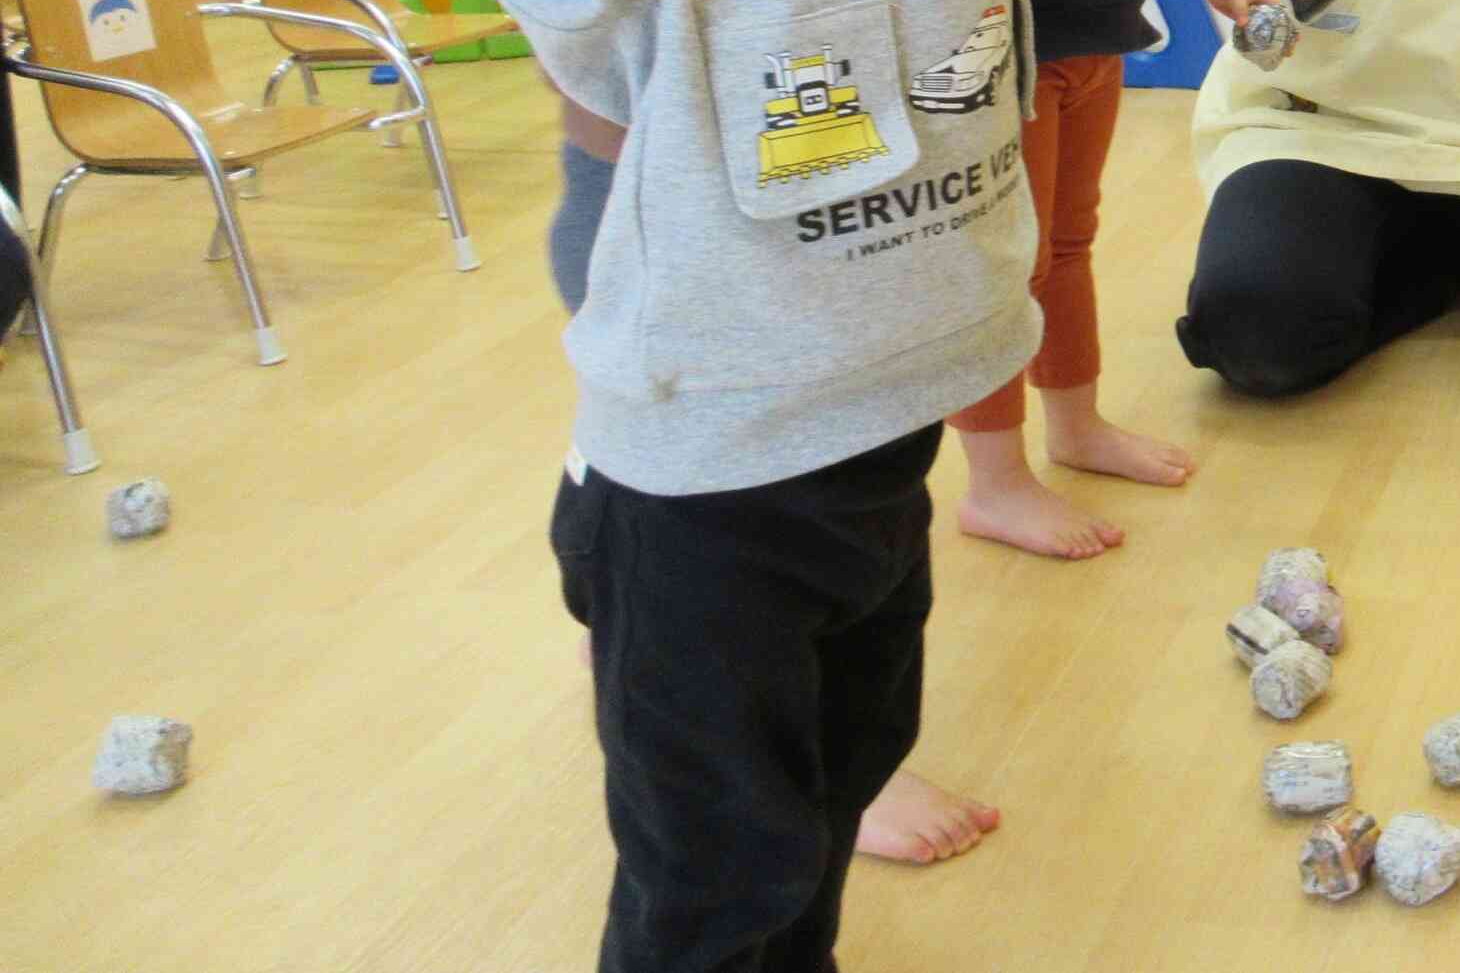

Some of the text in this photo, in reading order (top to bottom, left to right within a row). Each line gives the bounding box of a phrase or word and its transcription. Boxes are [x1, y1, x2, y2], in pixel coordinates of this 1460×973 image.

[797, 162, 984, 243] SERVICE
[859, 230, 916, 257] WANT
[922, 221, 946, 238] TO
